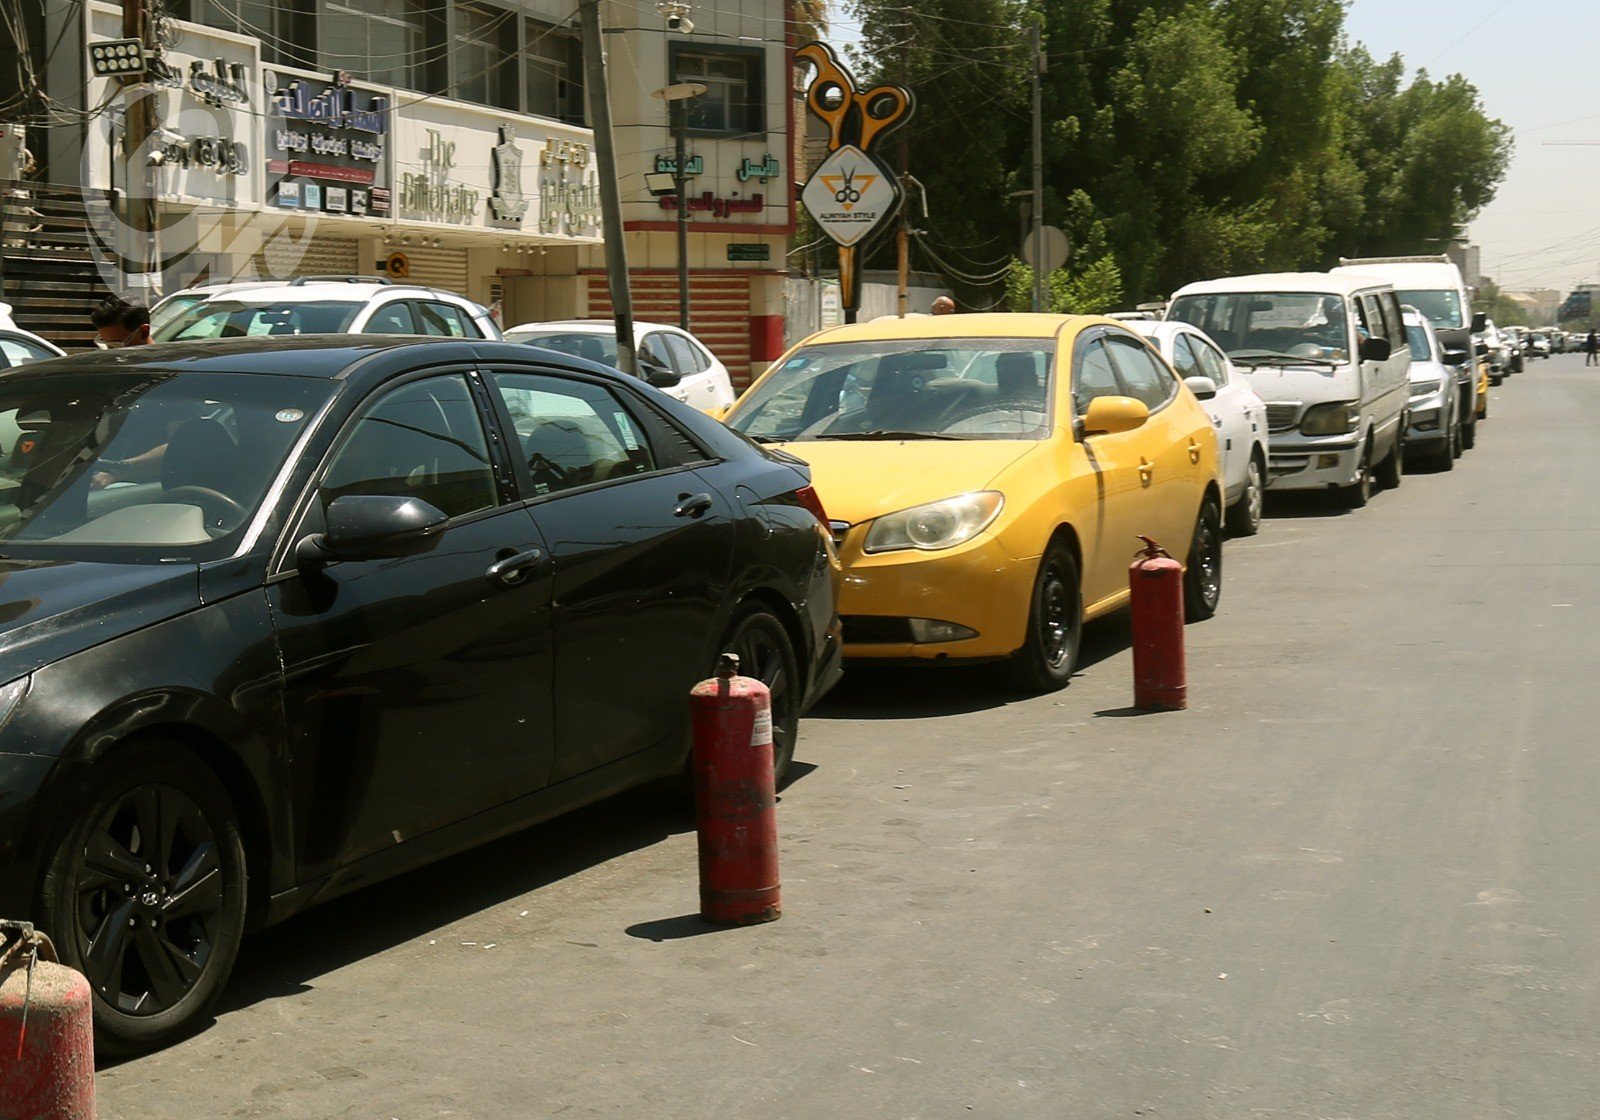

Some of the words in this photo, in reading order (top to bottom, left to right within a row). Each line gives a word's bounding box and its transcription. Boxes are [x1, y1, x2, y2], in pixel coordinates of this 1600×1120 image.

[426, 128, 457, 169] The
[656, 155, 703, 174] المدة
[401, 171, 480, 217] Billionaire
[660, 191, 723, 218] والسيحة
